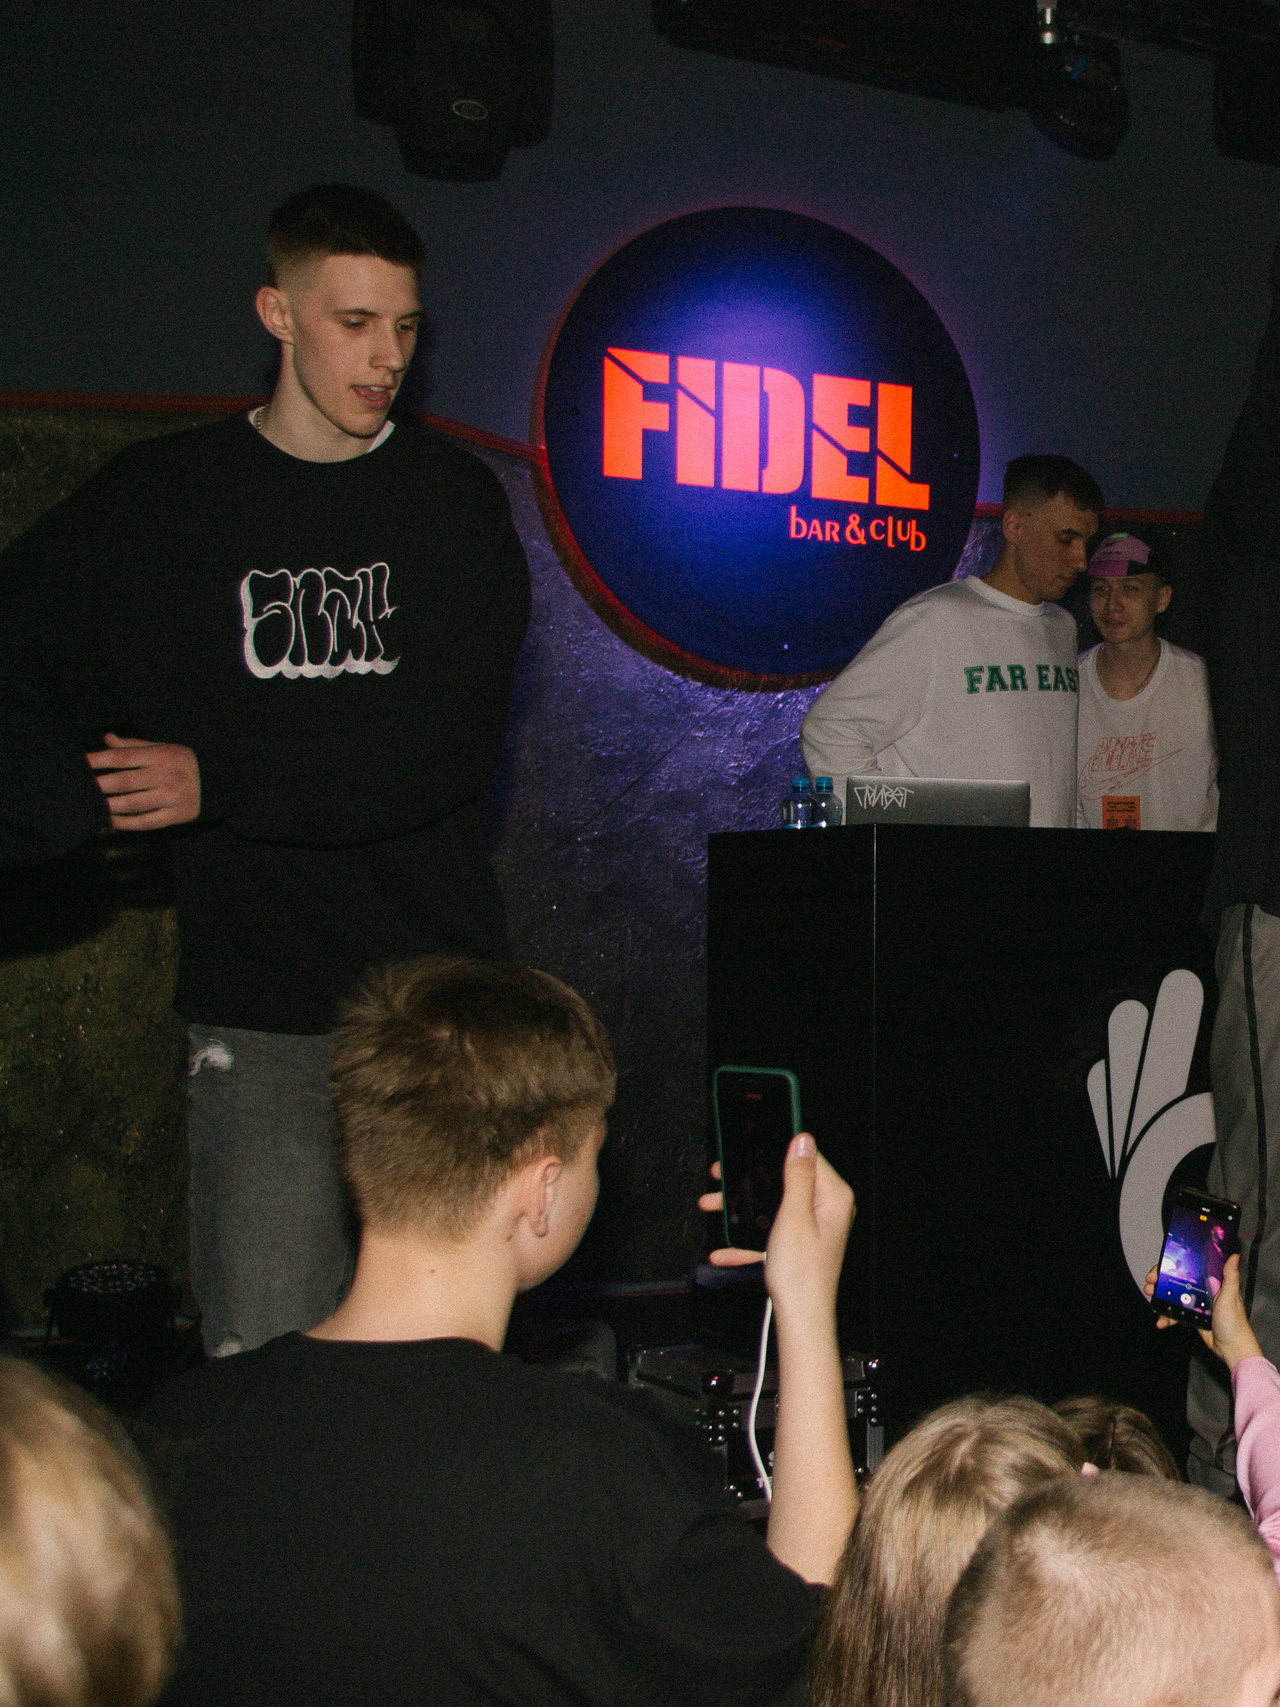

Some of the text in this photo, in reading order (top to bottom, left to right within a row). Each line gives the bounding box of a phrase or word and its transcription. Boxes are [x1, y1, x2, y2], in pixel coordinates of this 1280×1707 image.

[603, 347, 930, 511] FIDEL
[963, 663, 1079, 695] FAR EAS
